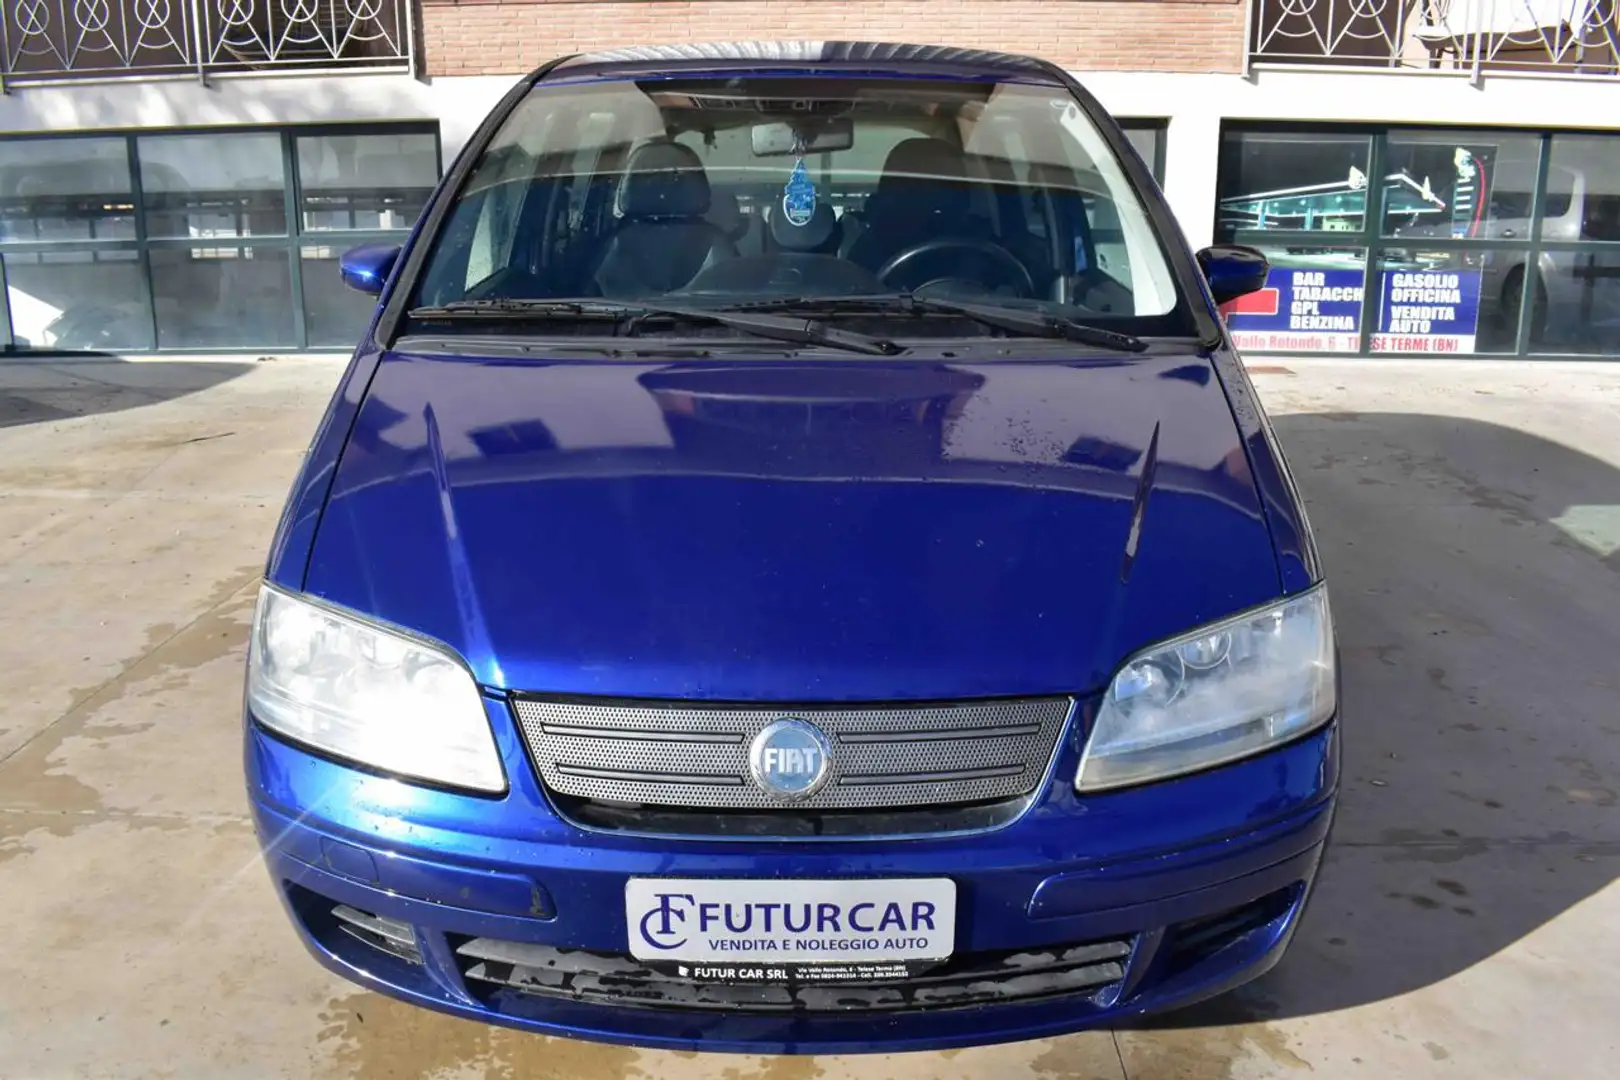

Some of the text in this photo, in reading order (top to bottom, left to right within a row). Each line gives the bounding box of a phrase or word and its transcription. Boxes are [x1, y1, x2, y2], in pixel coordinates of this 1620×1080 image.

[1292, 271, 1325, 286] BAR
[1392, 273, 1459, 289] GASOLIO
[1291, 286, 1365, 302] TABACCH
[1391, 288, 1462, 304] OFFICINA
[1291, 301, 1320, 315] GPL
[1390, 305, 1455, 320] VENDITA
[1289, 315, 1355, 330] BENZINA
[1388, 319, 1431, 333] AUTO
[1390, 336, 1429, 352] TERME
[1432, 336, 1459, 352] (BN)
[764, 747, 819, 774] FIAT
[709, 937, 929, 951] VENDITA E NOLEGGIO AUTO
[694, 967, 788, 979] FUTUR CAR SRL
